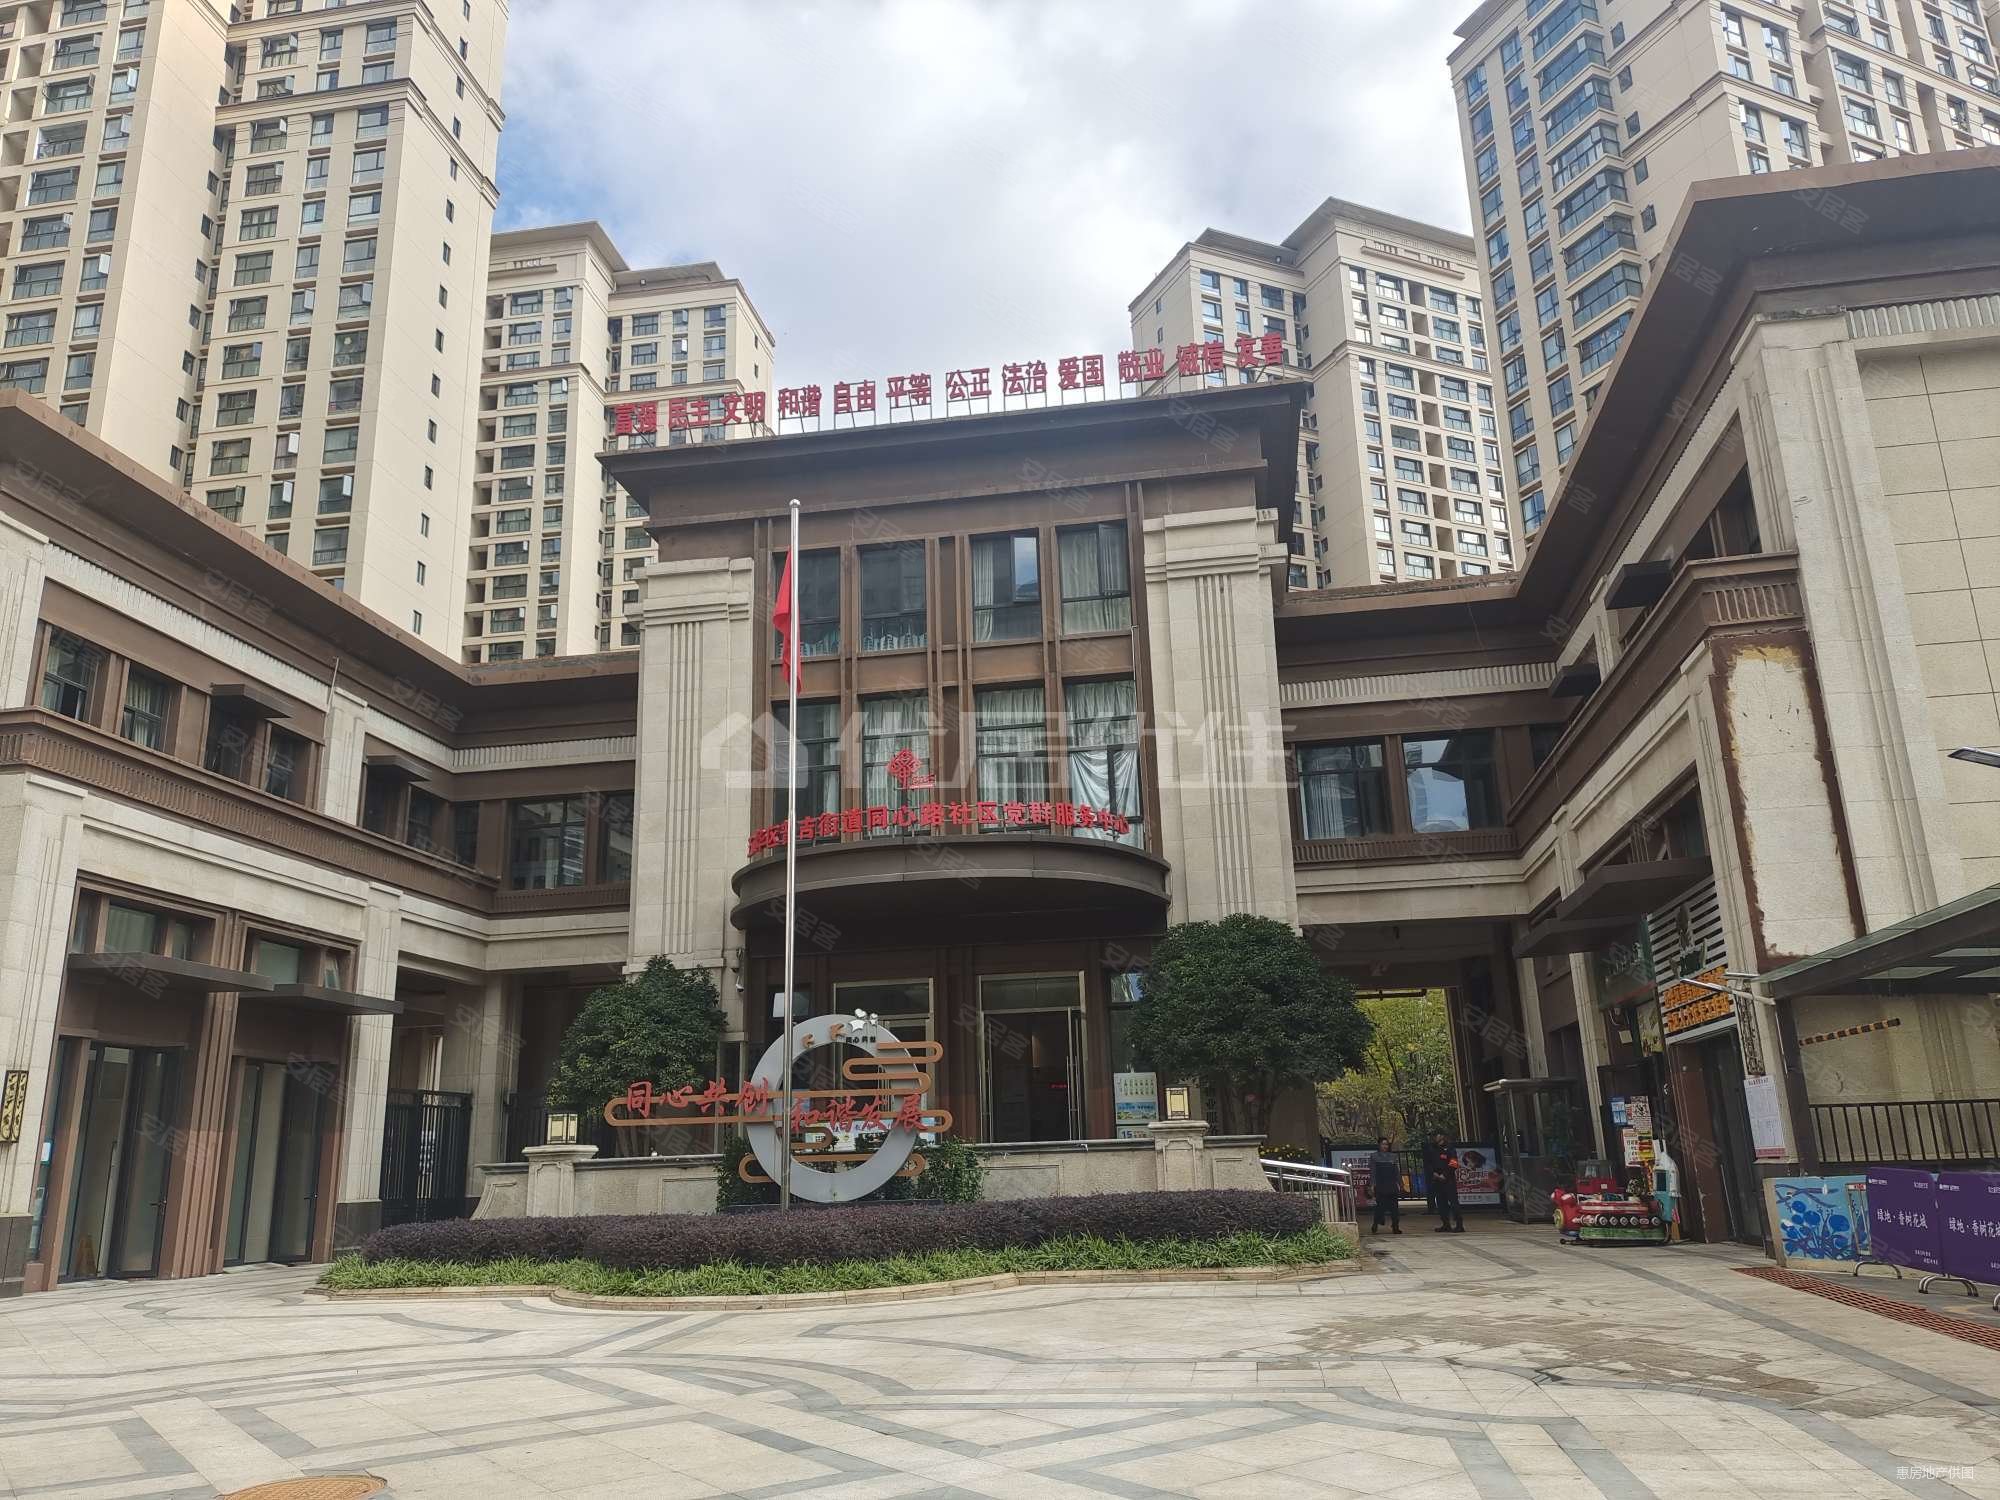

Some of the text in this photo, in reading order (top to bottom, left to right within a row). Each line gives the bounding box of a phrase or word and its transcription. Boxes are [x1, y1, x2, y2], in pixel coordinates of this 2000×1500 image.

[615, 332, 1284, 435] 富强 民主 文明 和谐 自由 平等 公正 法治 爱国 敬业 诚信 友善
[627, 1077, 769, 1119] 同心共创
